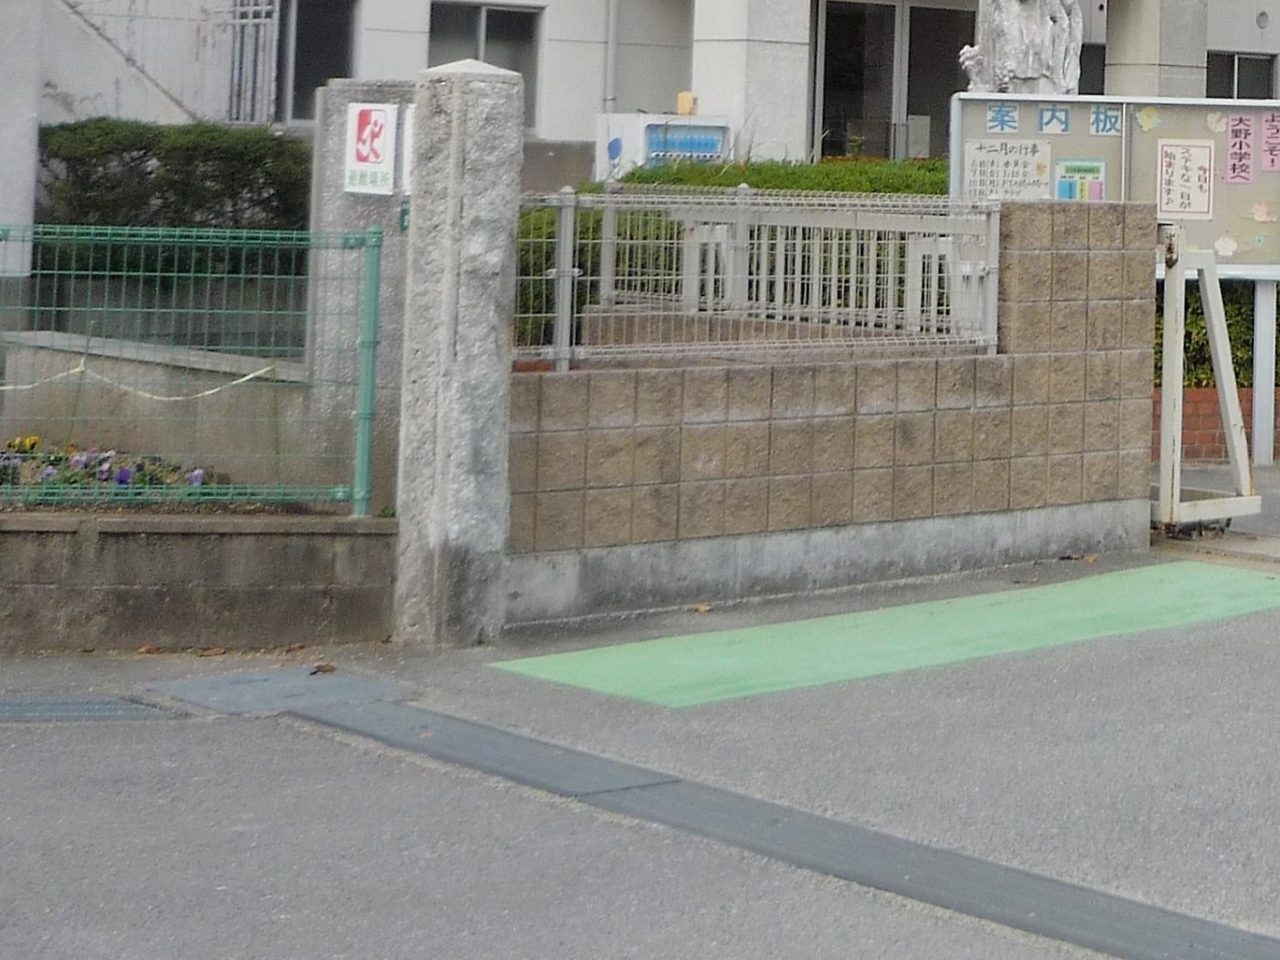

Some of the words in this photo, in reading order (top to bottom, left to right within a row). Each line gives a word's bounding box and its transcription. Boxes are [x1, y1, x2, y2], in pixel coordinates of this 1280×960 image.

[987, 101, 1121, 133] 案内板
[1230, 117, 1251, 180] 大野小学校へ
